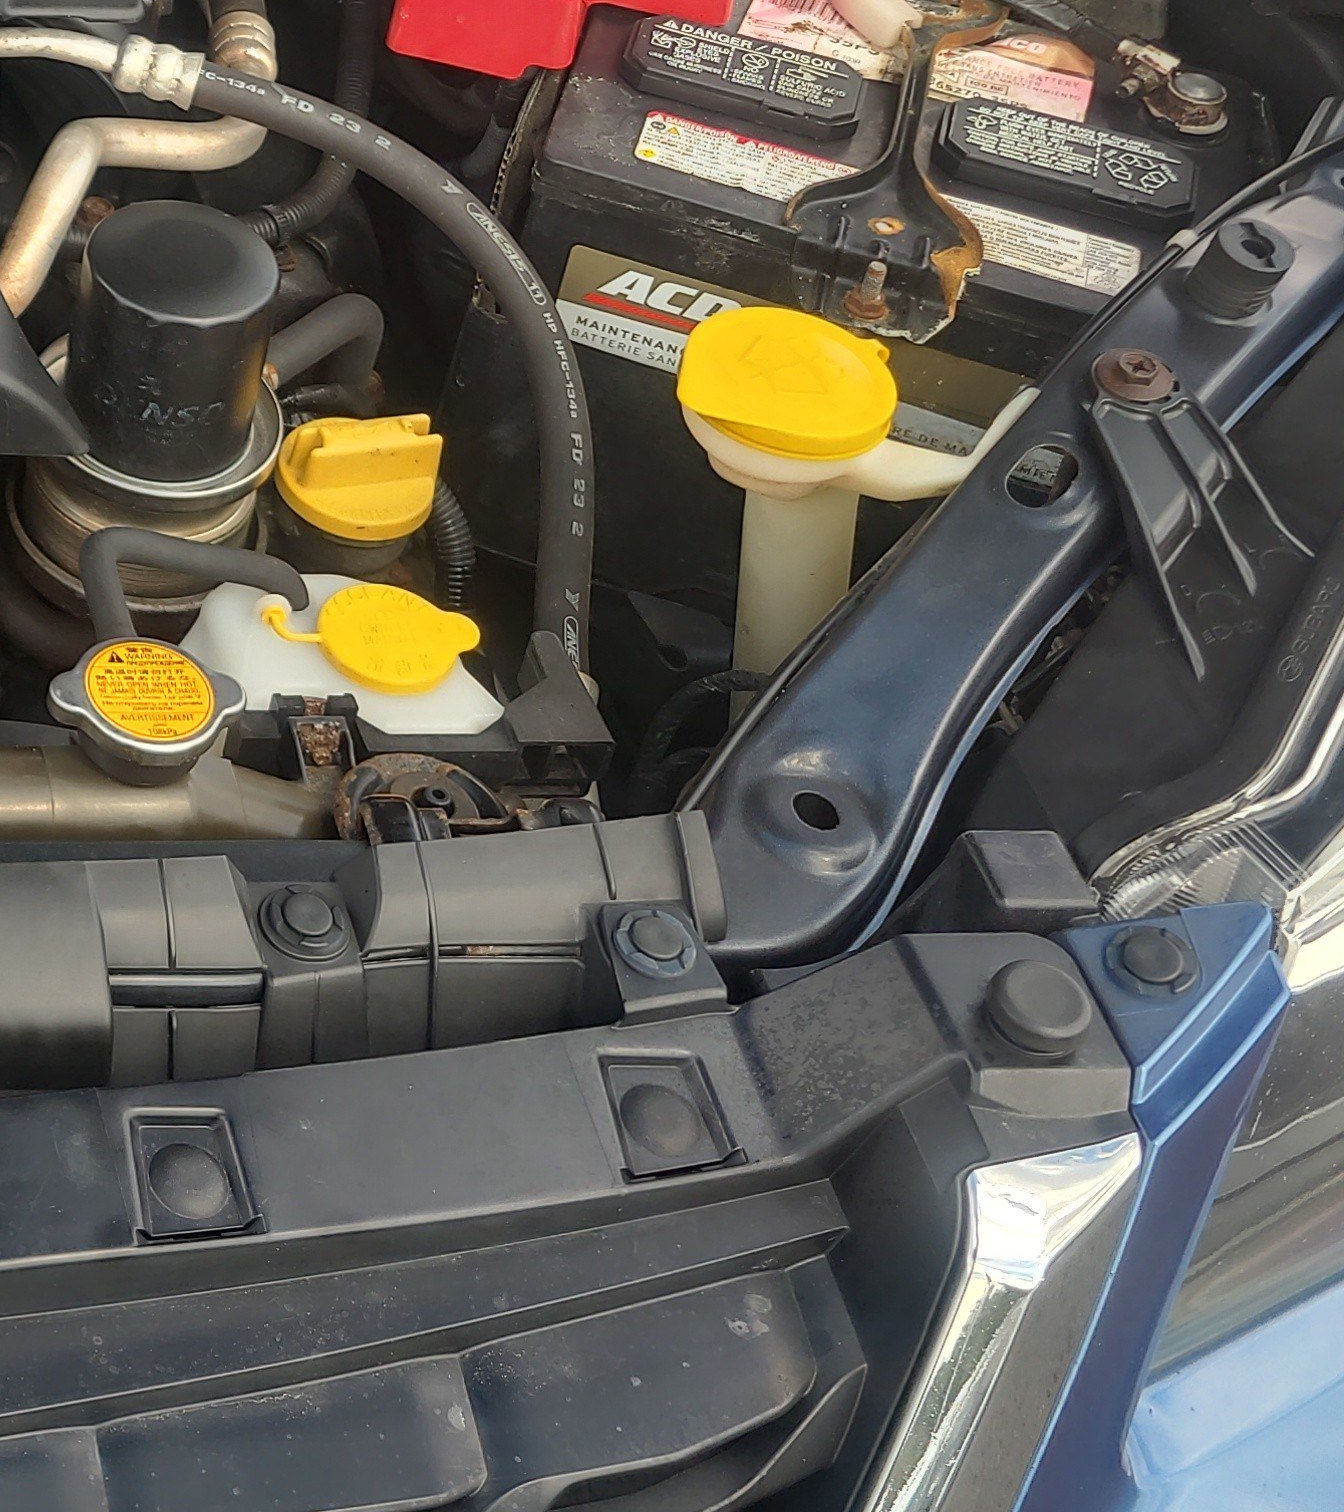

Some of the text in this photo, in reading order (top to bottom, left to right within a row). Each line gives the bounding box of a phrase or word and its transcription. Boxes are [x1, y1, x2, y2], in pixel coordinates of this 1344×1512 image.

[682, 25, 752, 49] DANGER
[771, 48, 836, 71] POISON
[743, 65, 758, 73] NO
[823, 87, 845, 97] ACID
[280, 94, 392, 151] FD 23 2
[541, 312, 559, 333] HP
[575, 316, 685, 357] MAINTENAN
[571, 328, 677, 368] BATTERIE SAN
[570, 432, 583, 466] FD
[891, 426, 968, 456] RE DE MA
[573, 478, 586, 509] 23
[571, 521, 584, 537] 2
